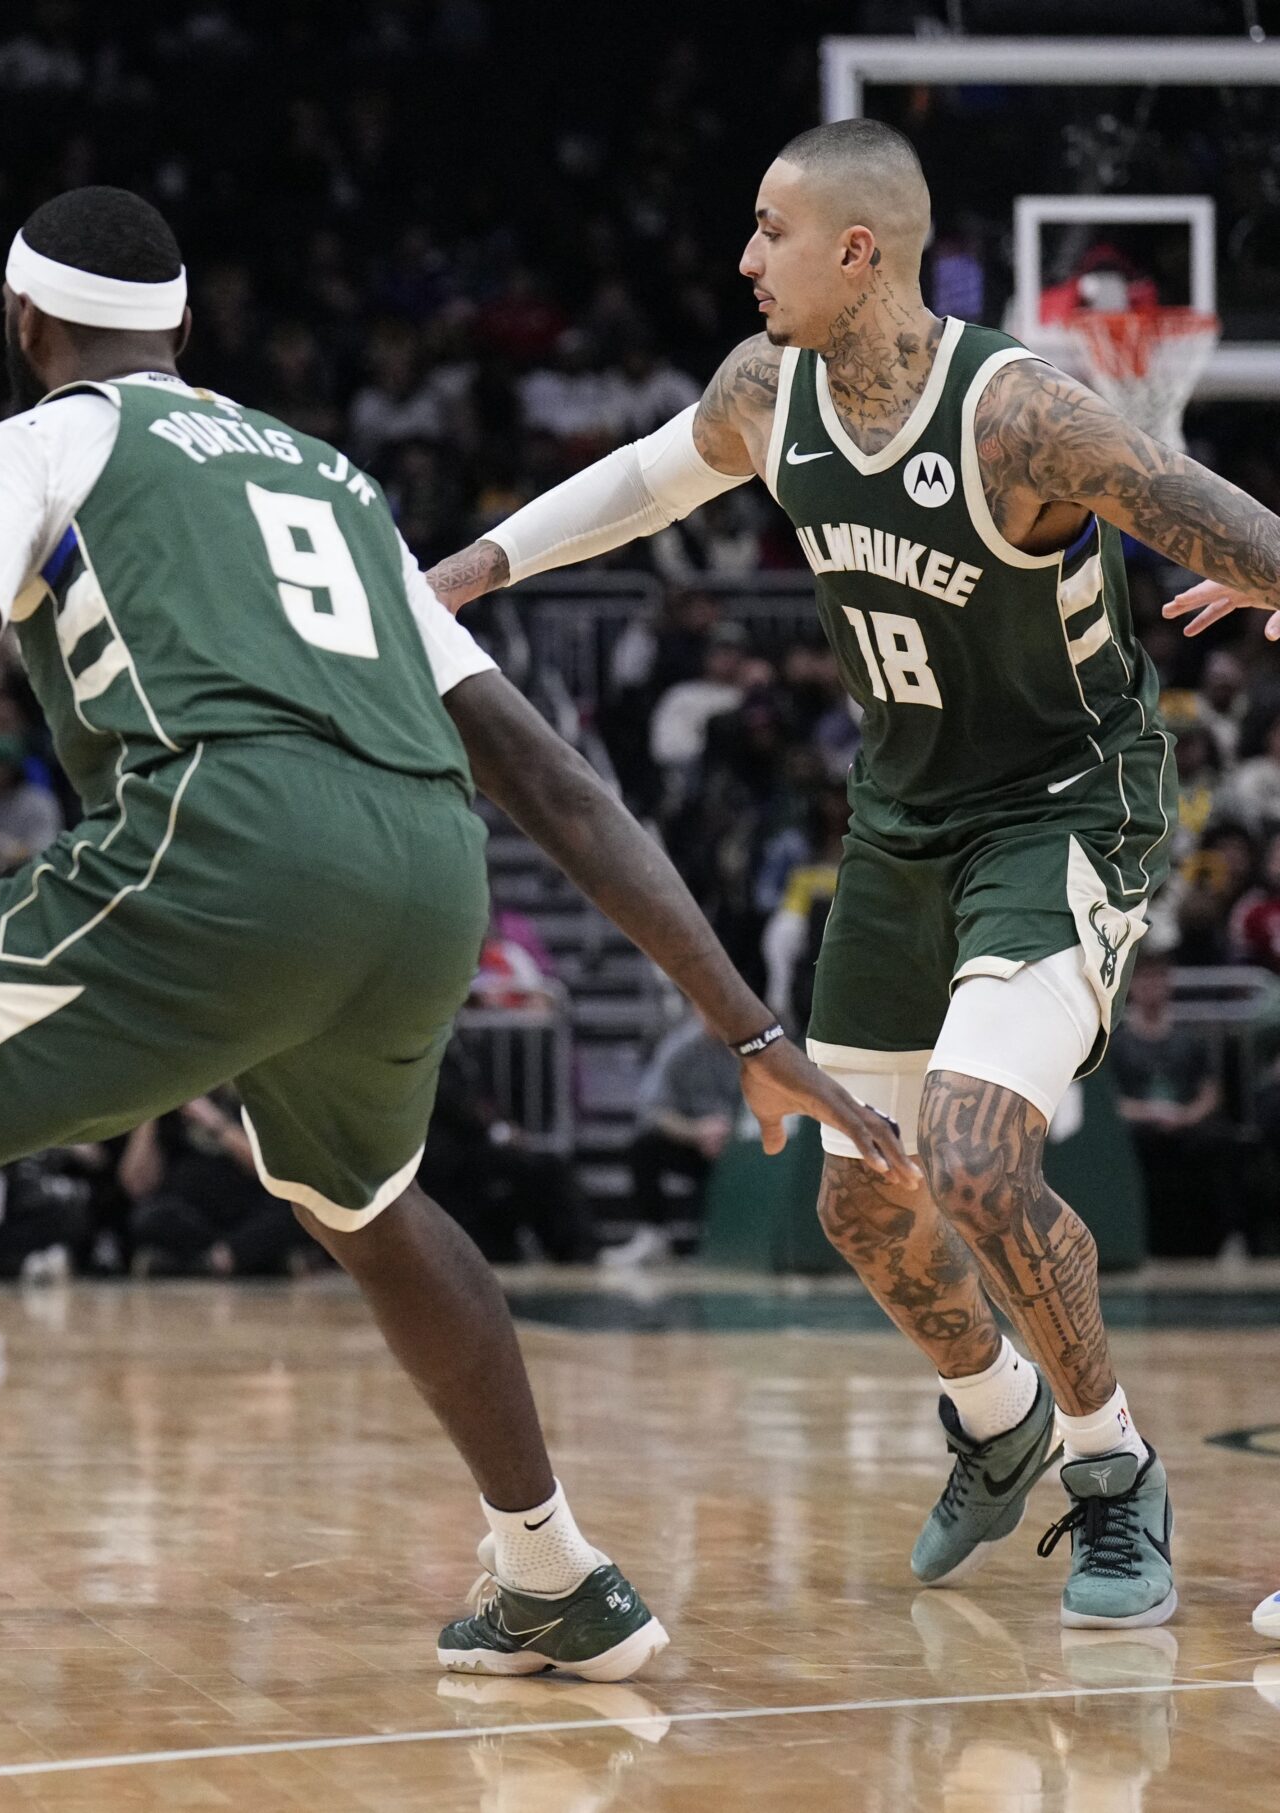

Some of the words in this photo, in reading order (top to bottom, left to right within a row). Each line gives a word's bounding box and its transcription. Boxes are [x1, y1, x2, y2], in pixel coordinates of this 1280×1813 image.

[148, 411, 303, 464] PORTIS
[245, 480, 380, 659] 9
[796, 523, 984, 608] ILWAUKEE
[841, 604, 944, 709] 18
